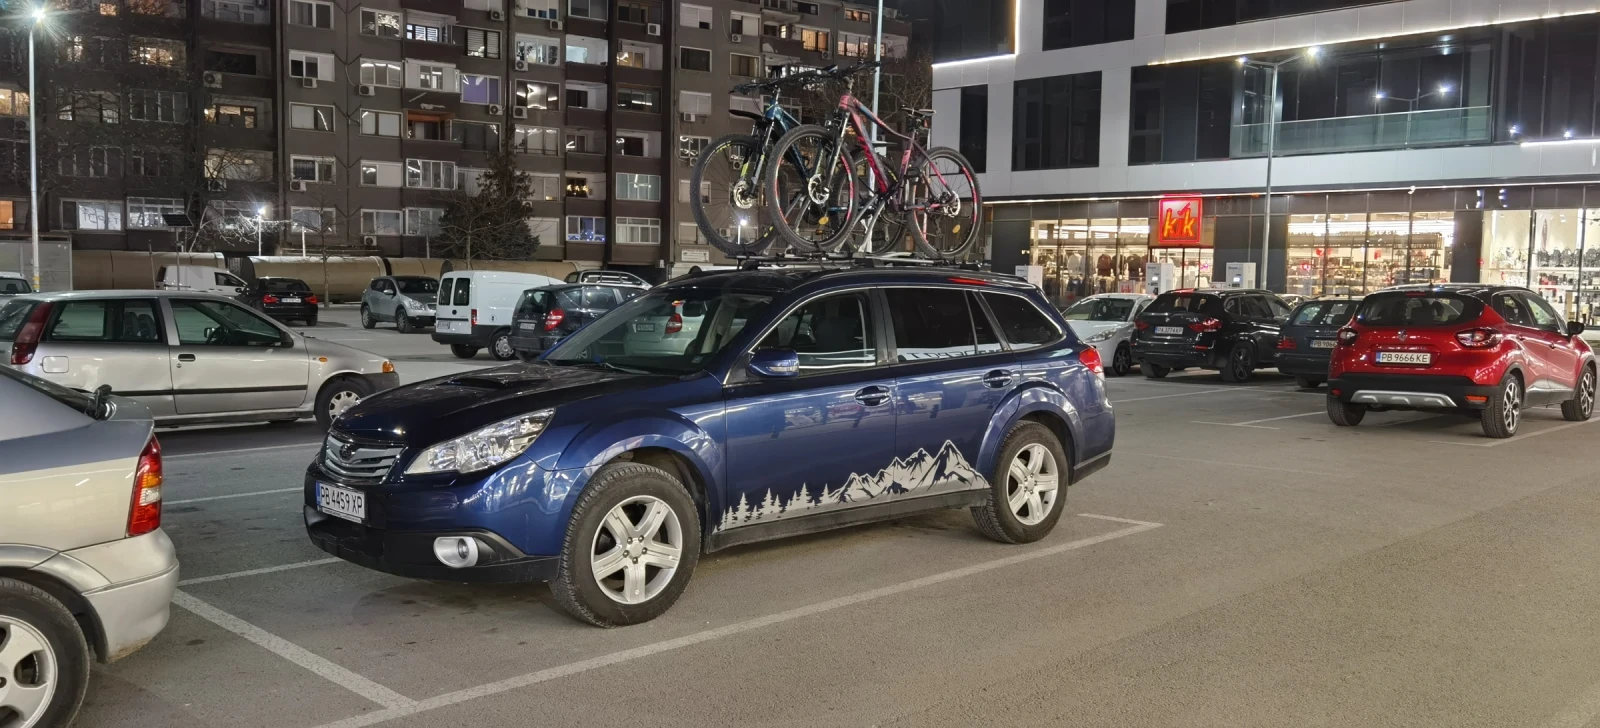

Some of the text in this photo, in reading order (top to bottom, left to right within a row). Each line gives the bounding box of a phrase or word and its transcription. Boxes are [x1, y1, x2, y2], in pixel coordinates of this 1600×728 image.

[1381, 353, 1429, 363] PB 9666 KE
[320, 486, 363, 514] PB 4459 XP
